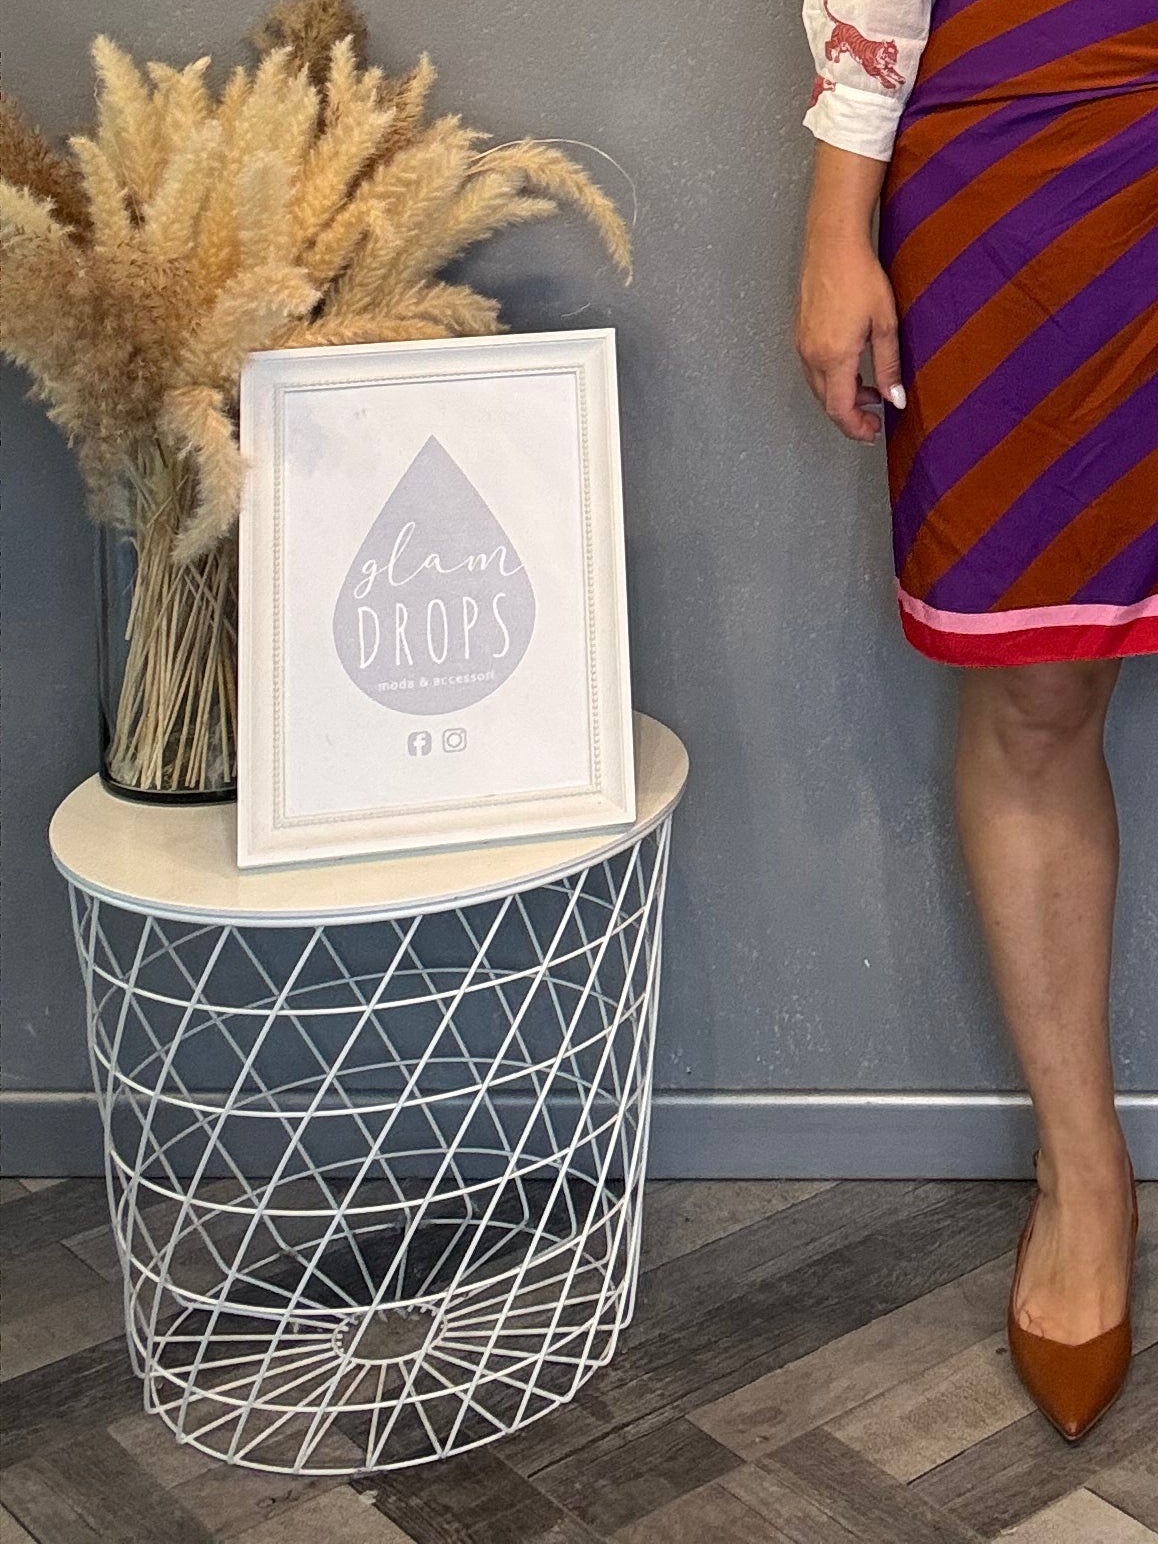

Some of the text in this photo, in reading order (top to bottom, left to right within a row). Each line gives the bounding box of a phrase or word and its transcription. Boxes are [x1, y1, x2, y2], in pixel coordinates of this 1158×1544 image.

[354, 522, 525, 599] glam
[357, 592, 511, 669] DROPS
[378, 678, 415, 691] moda
[419, 676, 429, 688] &
